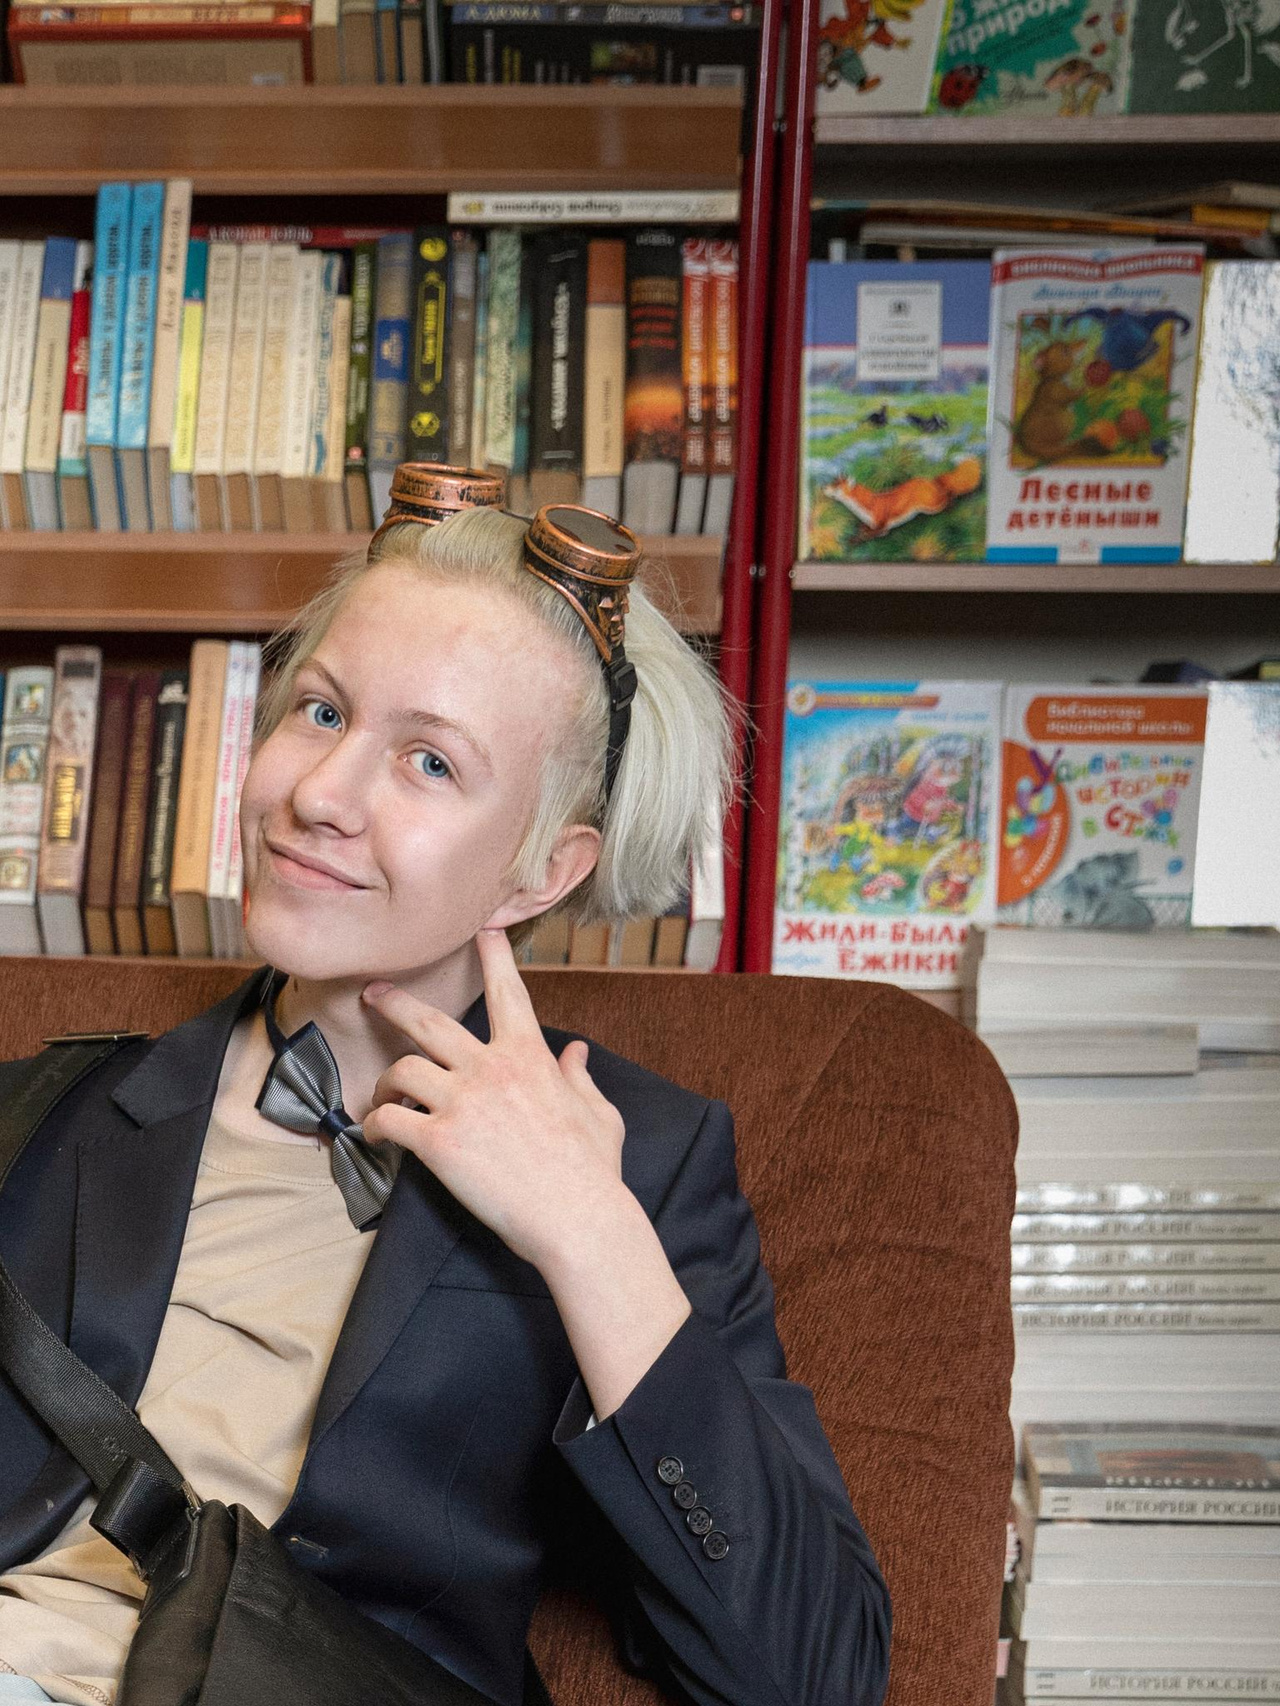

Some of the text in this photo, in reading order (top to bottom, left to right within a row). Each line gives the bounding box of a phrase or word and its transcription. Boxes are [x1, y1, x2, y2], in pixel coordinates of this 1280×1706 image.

[1020, 478, 1152, 504] Лесные
[1006, 506, 1160, 531] детёныши
[1105, 1500, 1197, 1515] ИСТОРИЯ
[1090, 1674, 1181, 1690] ИСТОРИЯ
[1187, 1675, 1268, 1691] РОССИИ
